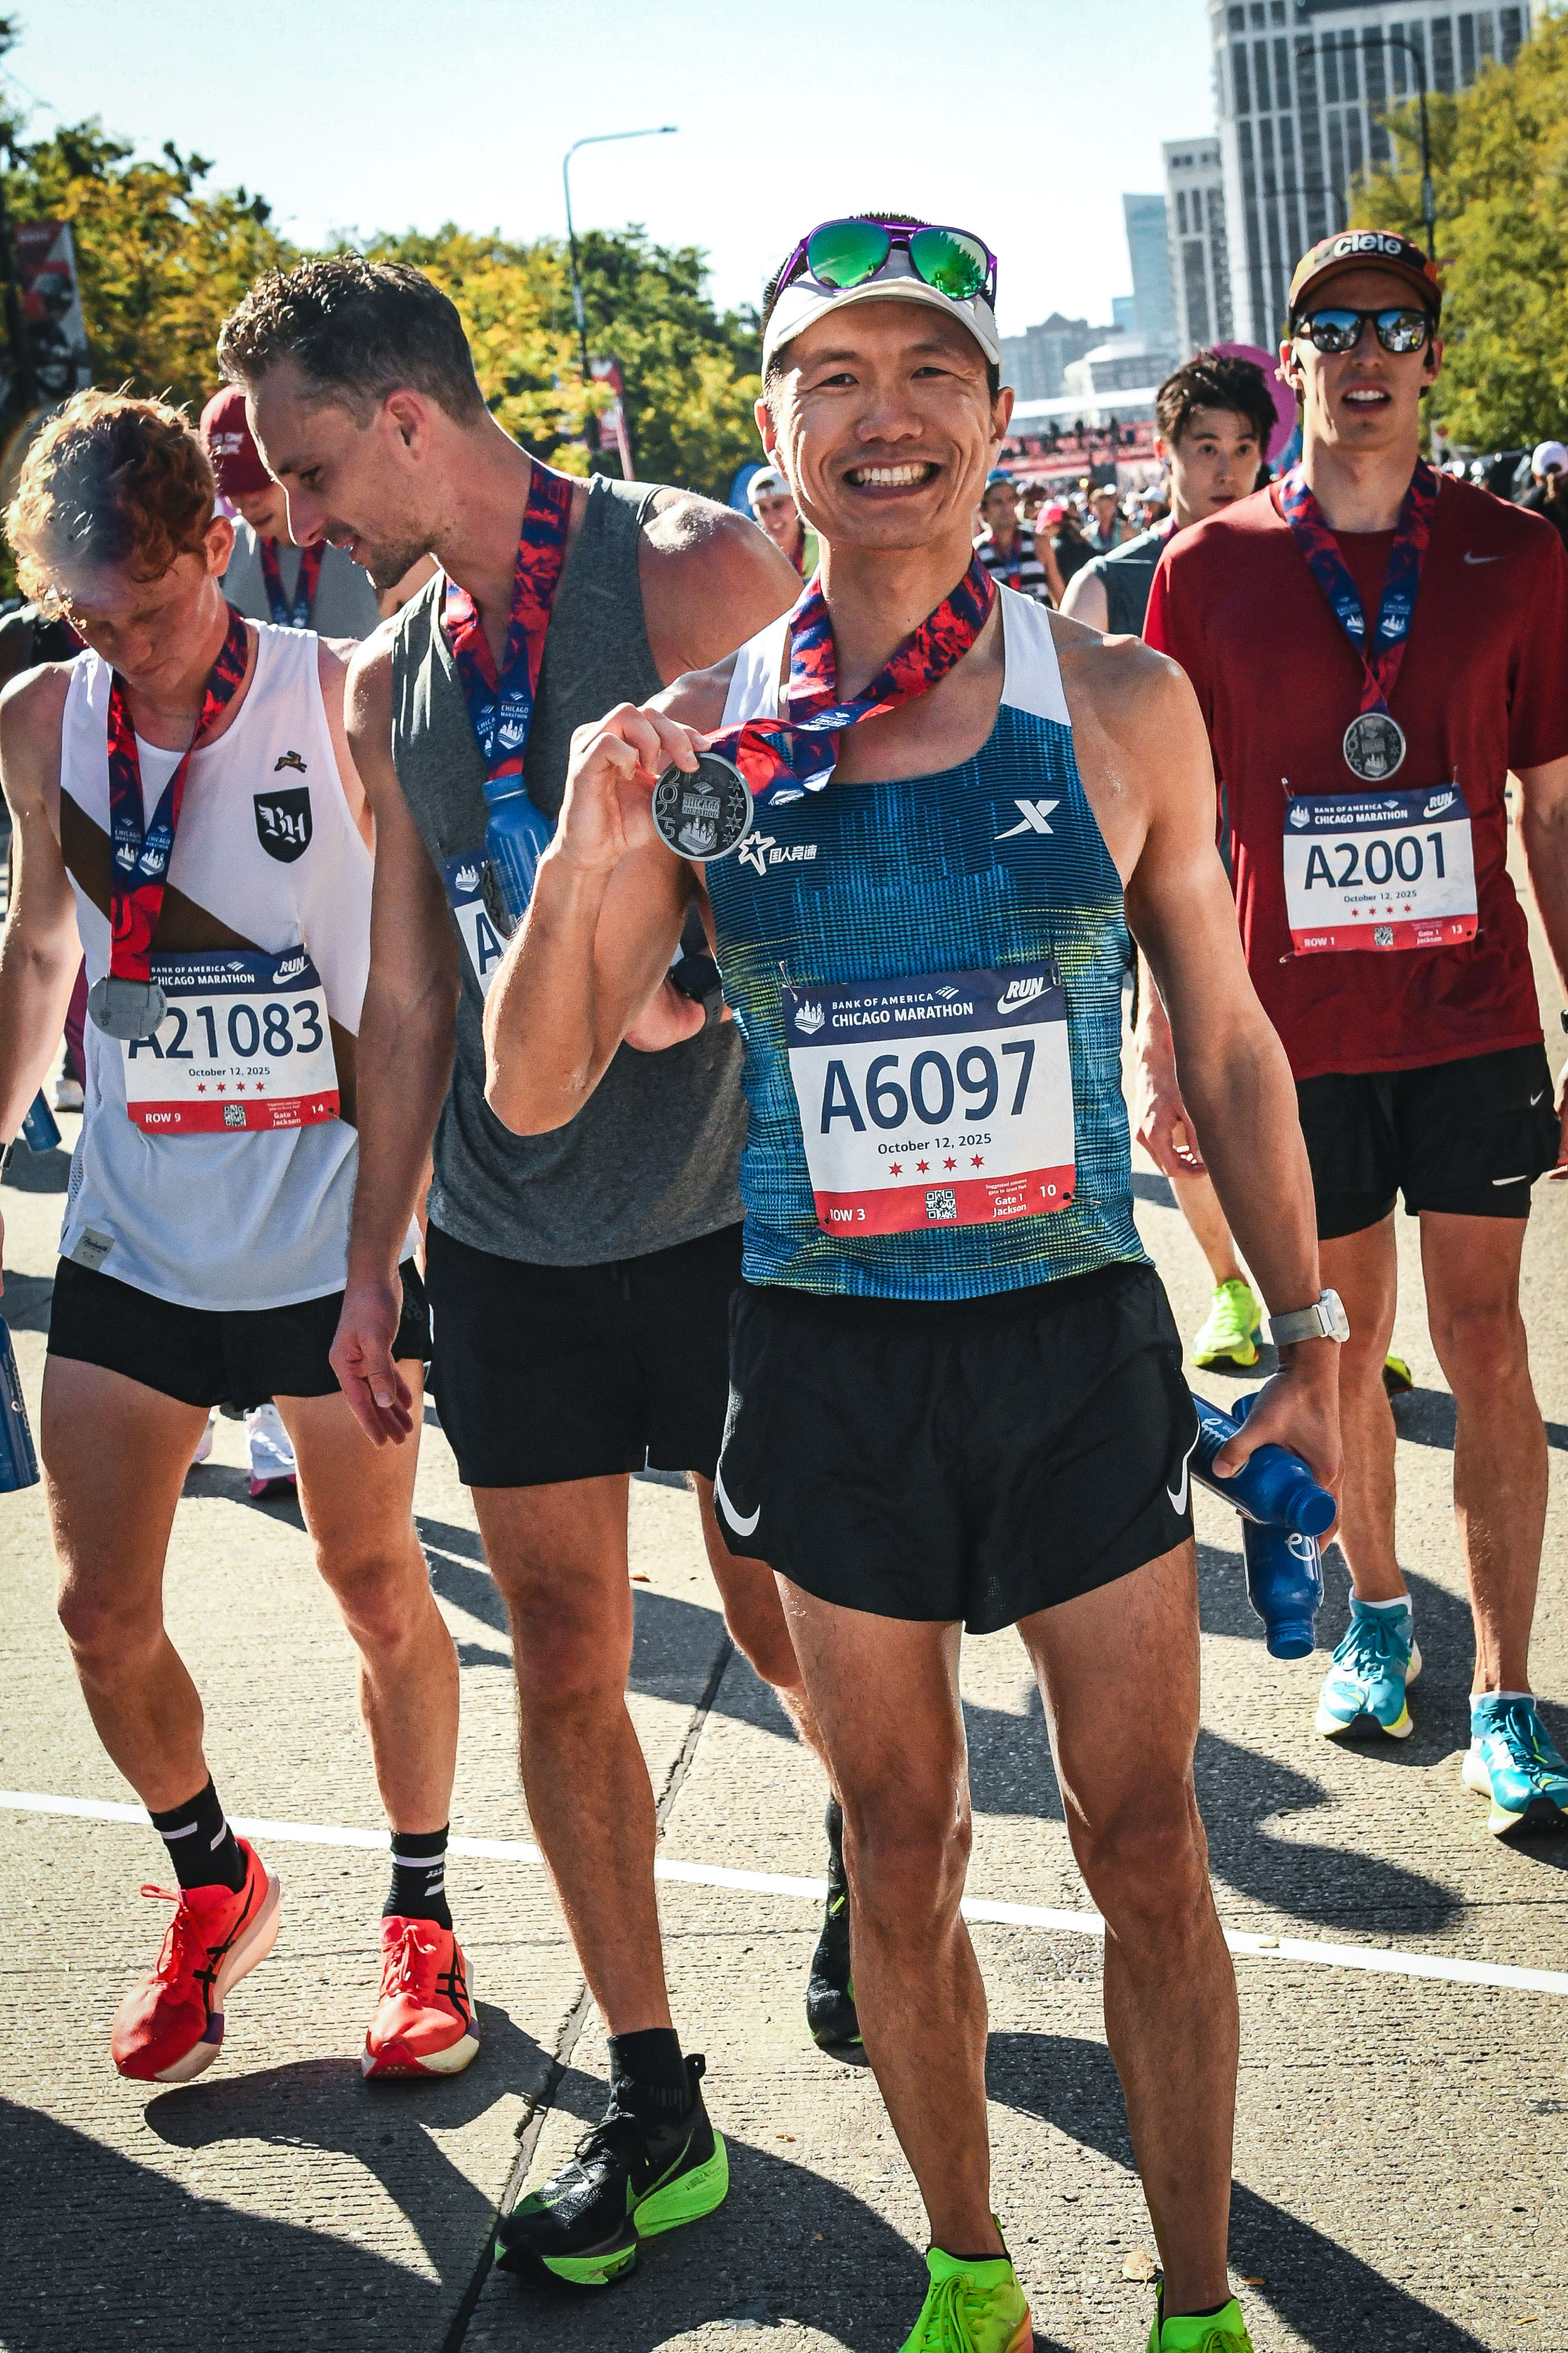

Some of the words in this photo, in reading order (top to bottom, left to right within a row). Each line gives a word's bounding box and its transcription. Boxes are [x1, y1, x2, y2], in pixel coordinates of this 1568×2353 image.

[1429, 792, 1453, 808] RUN
[1347, 804, 1383, 812] AMERICA
[1315, 814, 1353, 824] CHICAGO
[1356, 810, 1408, 822] MARATHON
[1305, 832, 1445, 889] A2001
[1344, 894, 1376, 903] October
[1396, 890, 1417, 898] 2025
[1452, 924, 1463, 934] 13
[1304, 938, 1327, 947] ROW
[1330, 937, 1335, 945] 1
[280, 956, 305, 973] RUN
[198, 974, 255, 985] MARATHON
[1006, 977, 1044, 999] RUN
[832, 1001, 861, 1010] BANK
[864, 998, 879, 1007] OF
[882, 993, 934, 1005] AMERICA
[832, 1010, 890, 1027] CHICAGO
[895, 1002, 974, 1022] MARATHON
[189, 1067, 226, 1076] October
[230, 1068, 245, 1076] 12,
[247, 1067, 270, 1075] 2025
[820, 1039, 1035, 1134] A6097
[312, 1104, 324, 1114] 14
[145, 1114, 171, 1123] ROW
[175, 1113, 181, 1122] 9
[878, 1140, 930, 1154] October
[935, 1137, 955, 1149] 12,
[959, 1133, 992, 1146] 2025
[1040, 1184, 1057, 1197] 10
[995, 1196, 1017, 1205] Gate
[1019, 1193, 1023, 1201] 1
[856, 1208, 866, 1221] 3
[993, 1204, 1027, 1218] Jackson
